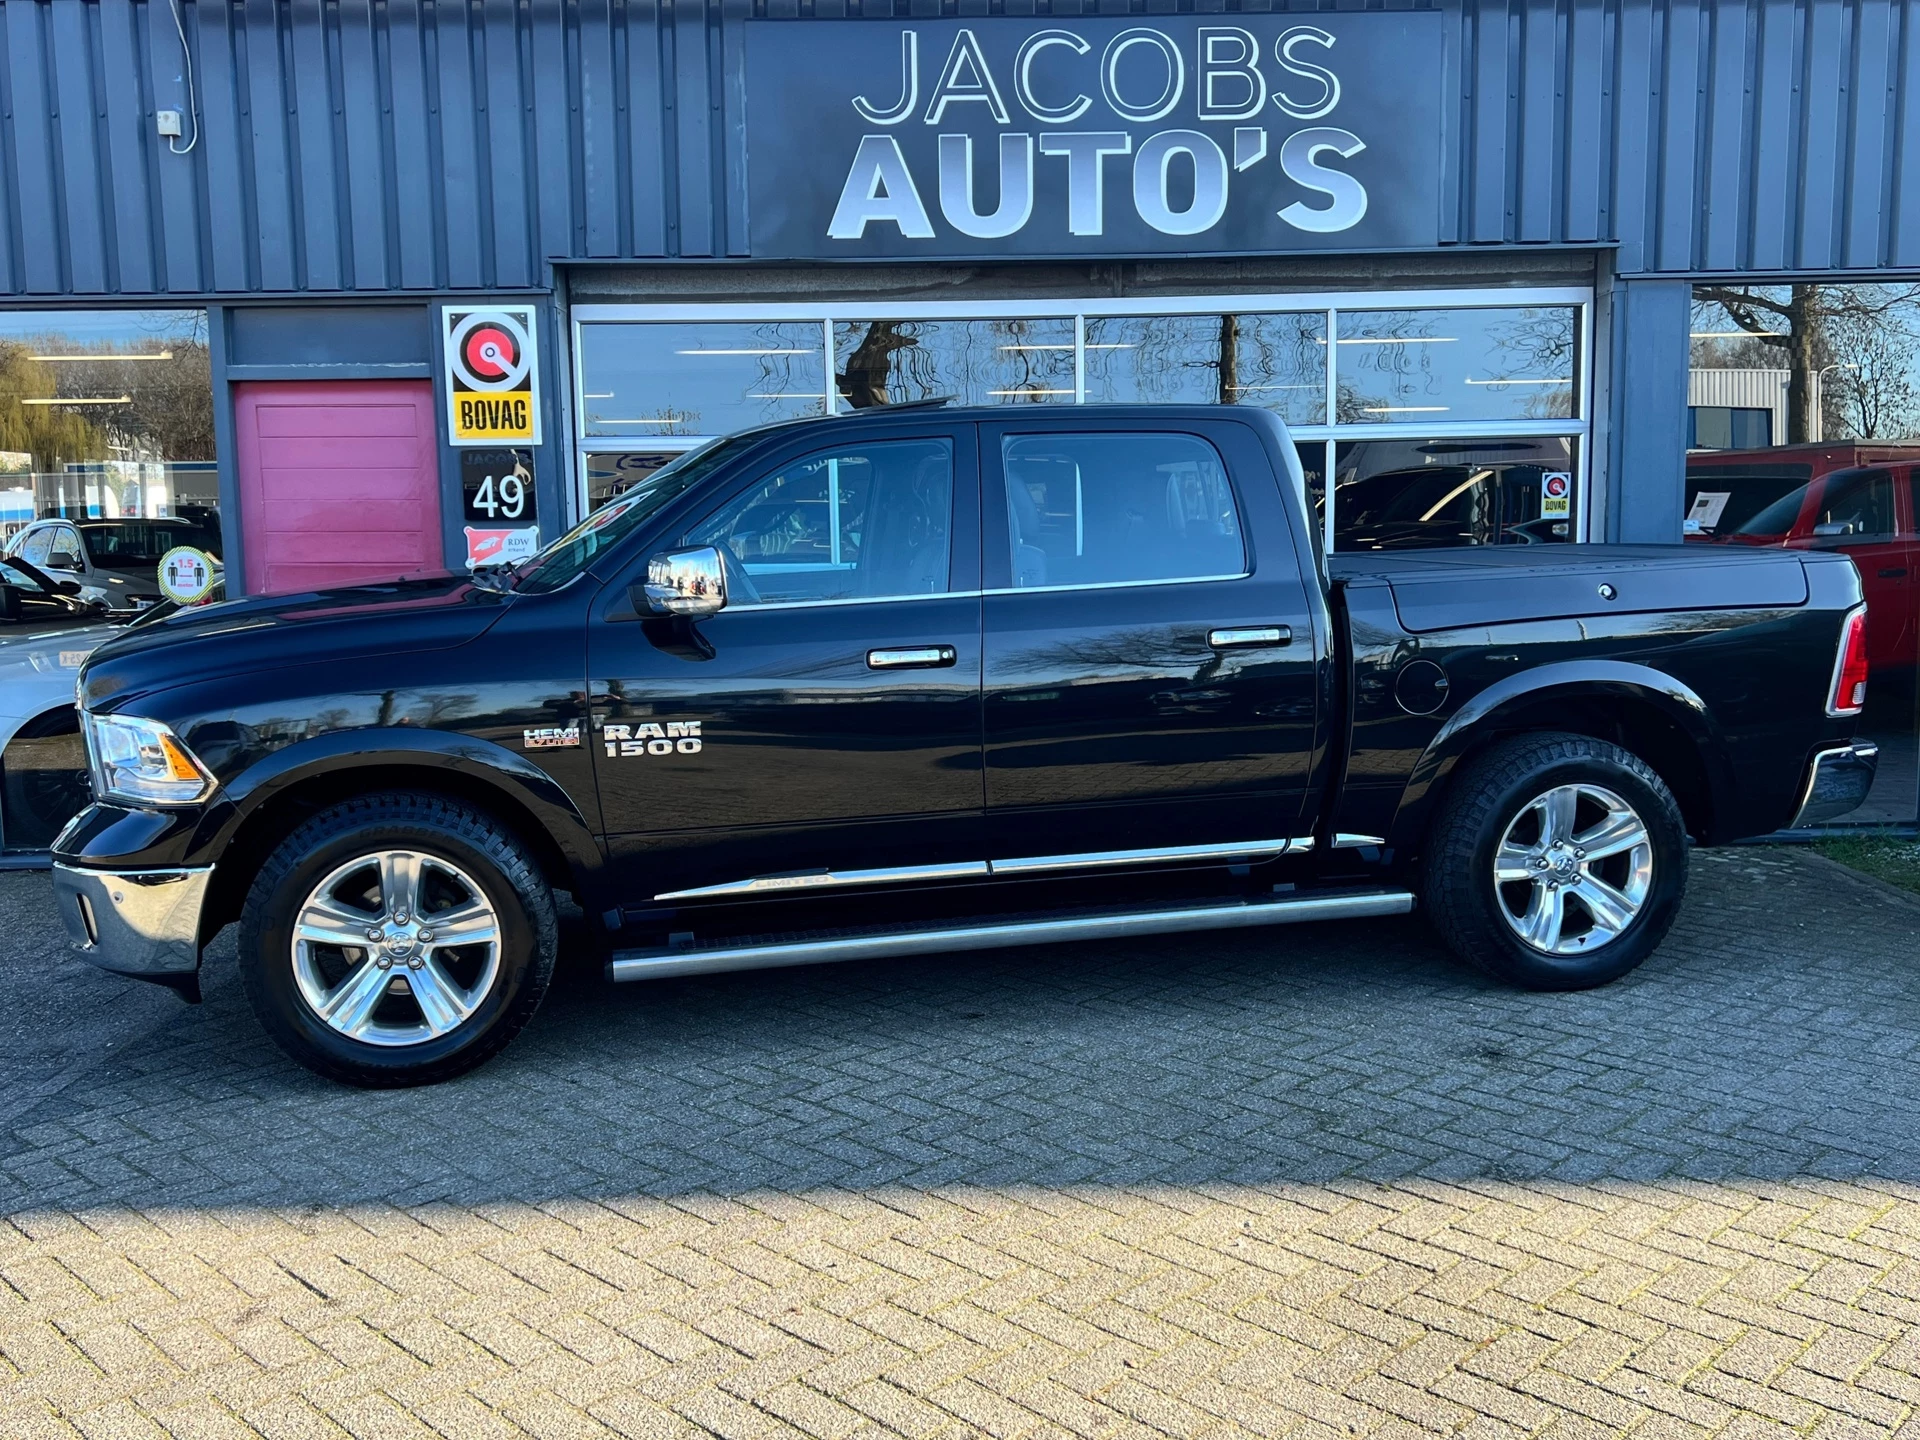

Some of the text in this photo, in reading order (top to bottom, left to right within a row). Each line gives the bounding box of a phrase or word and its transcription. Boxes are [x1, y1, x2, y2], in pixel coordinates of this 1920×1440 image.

[851, 25, 1341, 125] JACOBS
[826, 126, 1368, 239] AUTO'S
[461, 399, 526, 430] BOVAG
[472, 474, 524, 518] 49
[1545, 500, 1566, 511] BOVAG
[507, 538, 530, 546] RDW
[523, 727, 579, 738] HEMI
[603, 721, 702, 741] RAM
[604, 738, 703, 758] 1500
